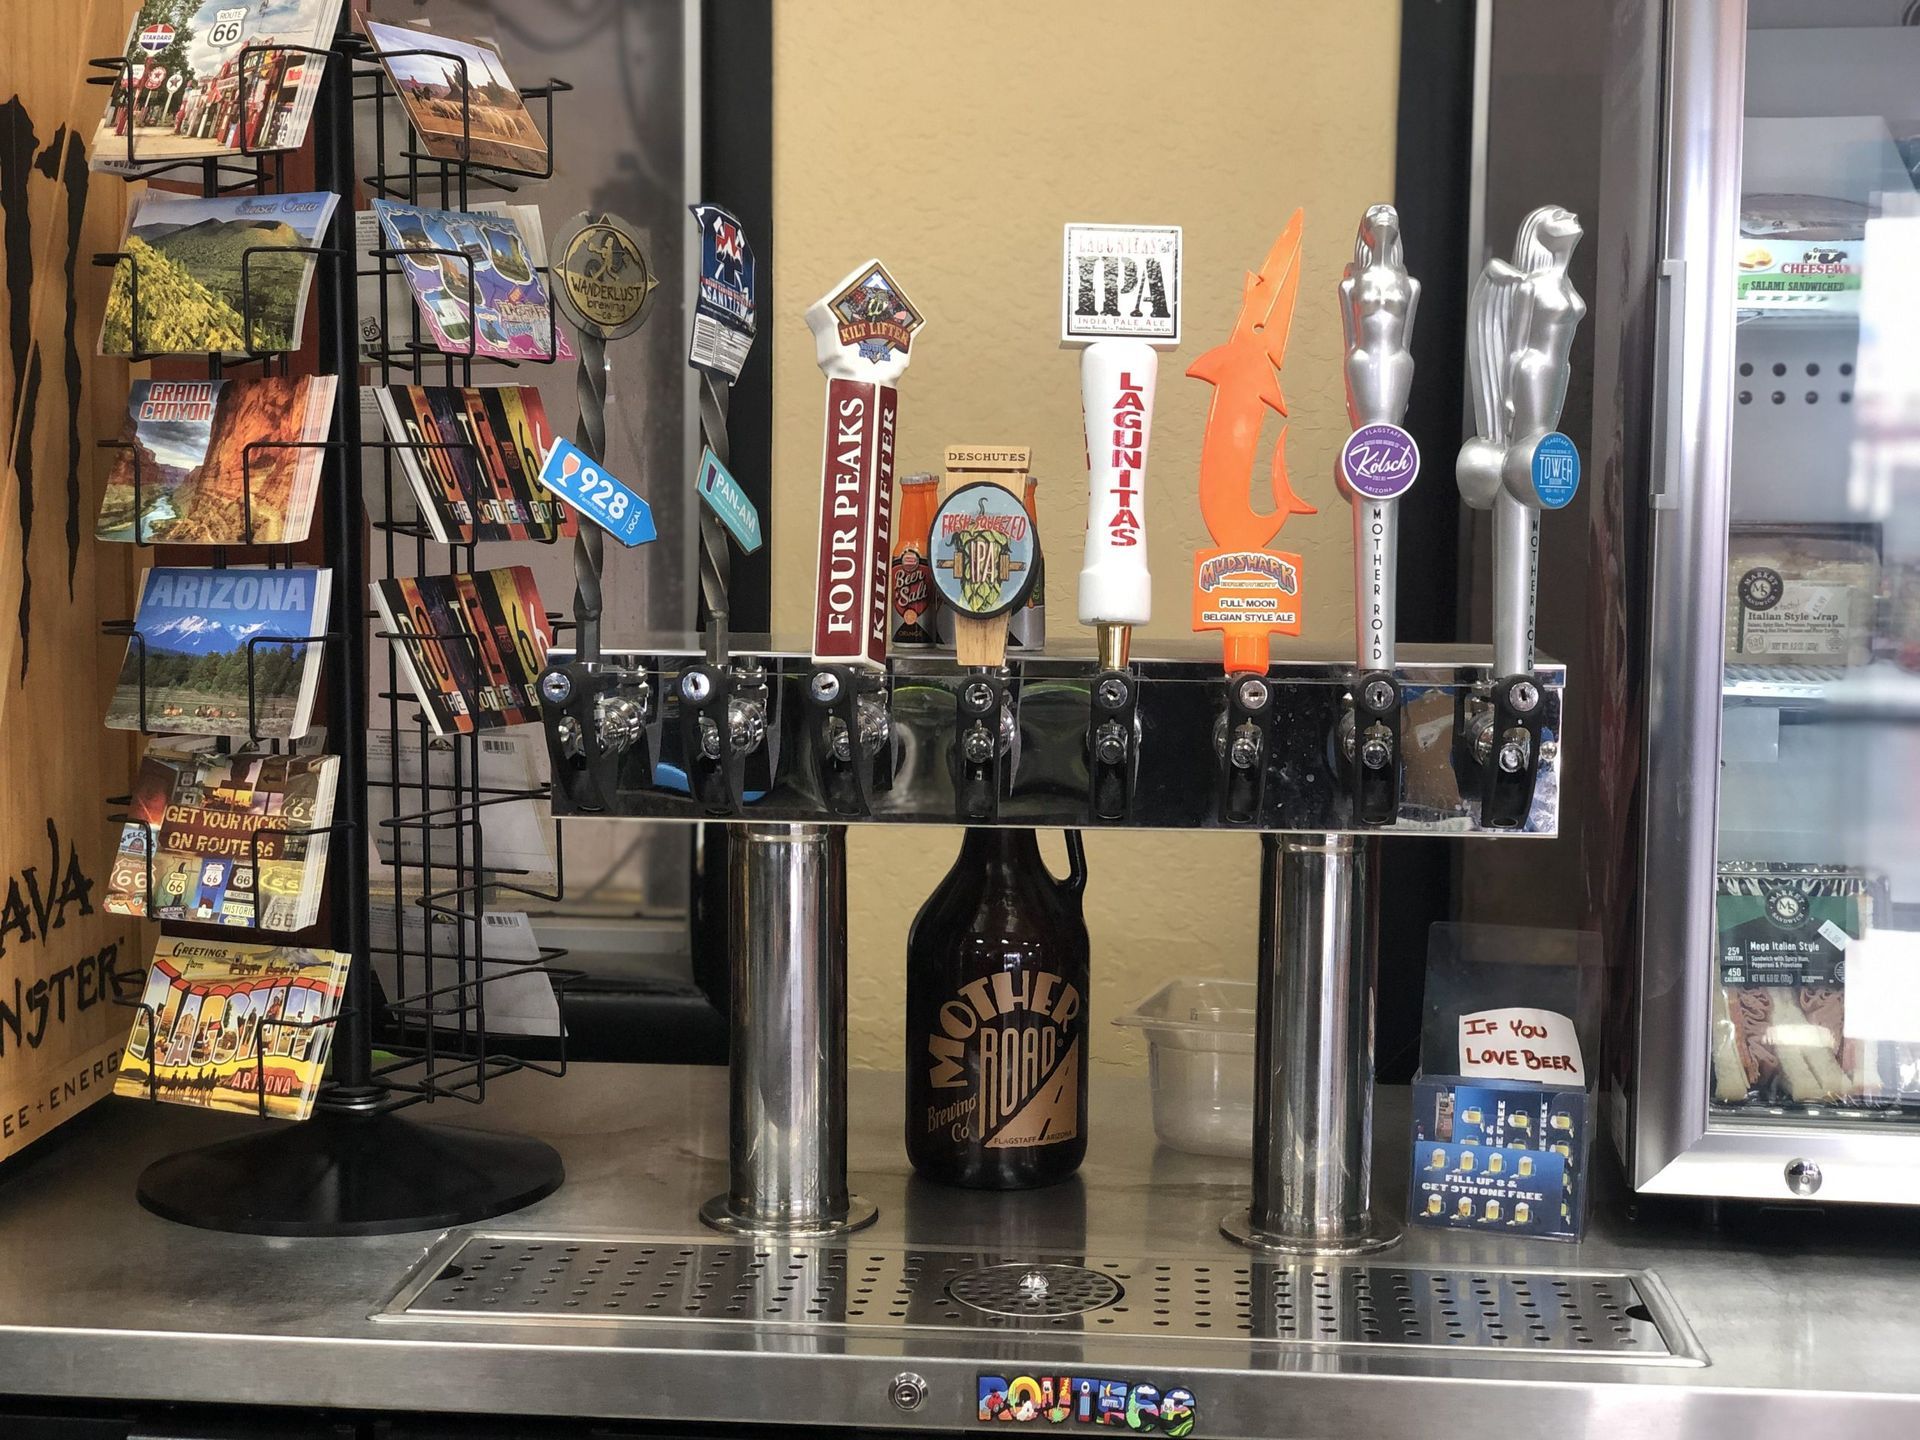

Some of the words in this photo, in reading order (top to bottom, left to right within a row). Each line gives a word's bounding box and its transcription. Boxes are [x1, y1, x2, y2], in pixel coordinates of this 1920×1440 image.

[219, 10, 243, 20] ROUTE
[142, 33, 172, 42] STANDARD
[213, 22, 239, 42] 66
[235, 199, 277, 215] Sunset
[281, 198, 319, 213] Crater
[571, 276, 641, 301] WANDERLUST
[1075, 256, 1171, 318] IPA
[1751, 281, 1785, 291] SALAMI
[1788, 282, 1845, 292] SANDWICHED
[586, 297, 626, 319] brewing
[363, 325, 376, 337] 66
[841, 323, 866, 341] KILT
[870, 321, 910, 345] LIFTER
[1114, 318, 1139, 326] PALE
[1146, 319, 1165, 327] ALE
[149, 383, 212, 401] GRAND
[139, 401, 212, 422] CANYON
[1365, 428, 1402, 438] FLAGSTAFF
[834, 397, 864, 519] PEAKS
[948, 452, 1026, 462] DESCHUTES
[1108, 372, 1145, 547] LAGUNITAS
[1348, 444, 1411, 477] Kölsch
[877, 408, 895, 543] LIFTER
[1539, 456, 1573, 486] TOWER
[578, 467, 629, 519] 928
[1364, 485, 1393, 494] ARIZONA
[444, 502, 473, 525] THE
[530, 501, 567, 524] ROD
[715, 472, 756, 534] PAN-AM
[625, 510, 642, 535] LOCAL
[970, 541, 995, 583] IPA
[1371, 508, 1383, 596] MOTHER
[827, 527, 858, 634] FOUR
[895, 569, 925, 588] Beer
[1200, 554, 1297, 594] MUDSHARK
[1744, 571, 1778, 586] MARKET
[148, 575, 306, 611] ARIZONA
[871, 557, 887, 641] KILT
[898, 581, 928, 607] Salt
[1220, 600, 1243, 608] FULL
[1246, 600, 1276, 608] MOON
[1203, 613, 1242, 622] BELGIAN
[1245, 613, 1273, 622] STYLE
[1276, 613, 1293, 622] ALE
[1748, 612, 1781, 621] Italian
[1784, 612, 1809, 623] Style
[1371, 604, 1383, 660] ROAD
[438, 690, 469, 716] THE
[166, 805, 200, 824] GET
[203, 809, 241, 830] YOUR
[242, 813, 288, 832] KICKS
[121, 831, 156, 849] WELCOE
[168, 832, 193, 850] ON
[196, 836, 251, 856] ROUTE
[256, 840, 275, 857] 66
[0, 817, 94, 958] AVA
[116, 869, 148, 889] 66
[169, 881, 183, 893] 66
[206, 874, 219, 885] 66
[236, 874, 251, 886] 66
[271, 877, 300, 889] 66
[1770, 890, 1805, 904] MARKET
[1779, 900, 1797, 914] MS
[224, 902, 255, 917] HISTORIC
[270, 912, 294, 928] 66
[1771, 911, 1805, 924] SANDWICH
[172, 941, 229, 958] GREETINGS
[1750, 942, 1770, 951] Mega
[1772, 941, 1797, 950] Italian
[1800, 942, 1820, 952] Style
[183, 957, 204, 977] from
[1728, 967, 1741, 977] 450
[130, 960, 324, 1068] FLAGSTAFF
[928, 969, 1080, 1088] MOTHER
[1464, 1018, 1499, 1035] IF
[1509, 1018, 1548, 1039] YOU
[1465, 1047, 1519, 1066] LOVE
[1520, 1049, 1577, 1074] BEER
[4, 1104, 30, 1139] EE
[50, 1046, 126, 1110] ENERG
[231, 1070, 293, 1095] ARIONA
[978, 1026, 1056, 1140] ROAD
[928, 1092, 977, 1133] Brewing
[1496, 1100, 1506, 1134] FREE
[993, 1136, 1037, 1145] FLAGSTAFF
[1046, 1130, 1073, 1140] ARIZONA
[1421, 1182, 1449, 1192] GET
[1450, 1185, 1478, 1195] 9TH
[1479, 1188, 1506, 1198] ONE
[1507, 1190, 1543, 1201] FREE
[1445, 1174, 1475, 1185] FILL
[1476, 1177, 1494, 1186] UP
[1496, 1178, 1505, 1187] 8
[1507, 1179, 1518, 1189] &
